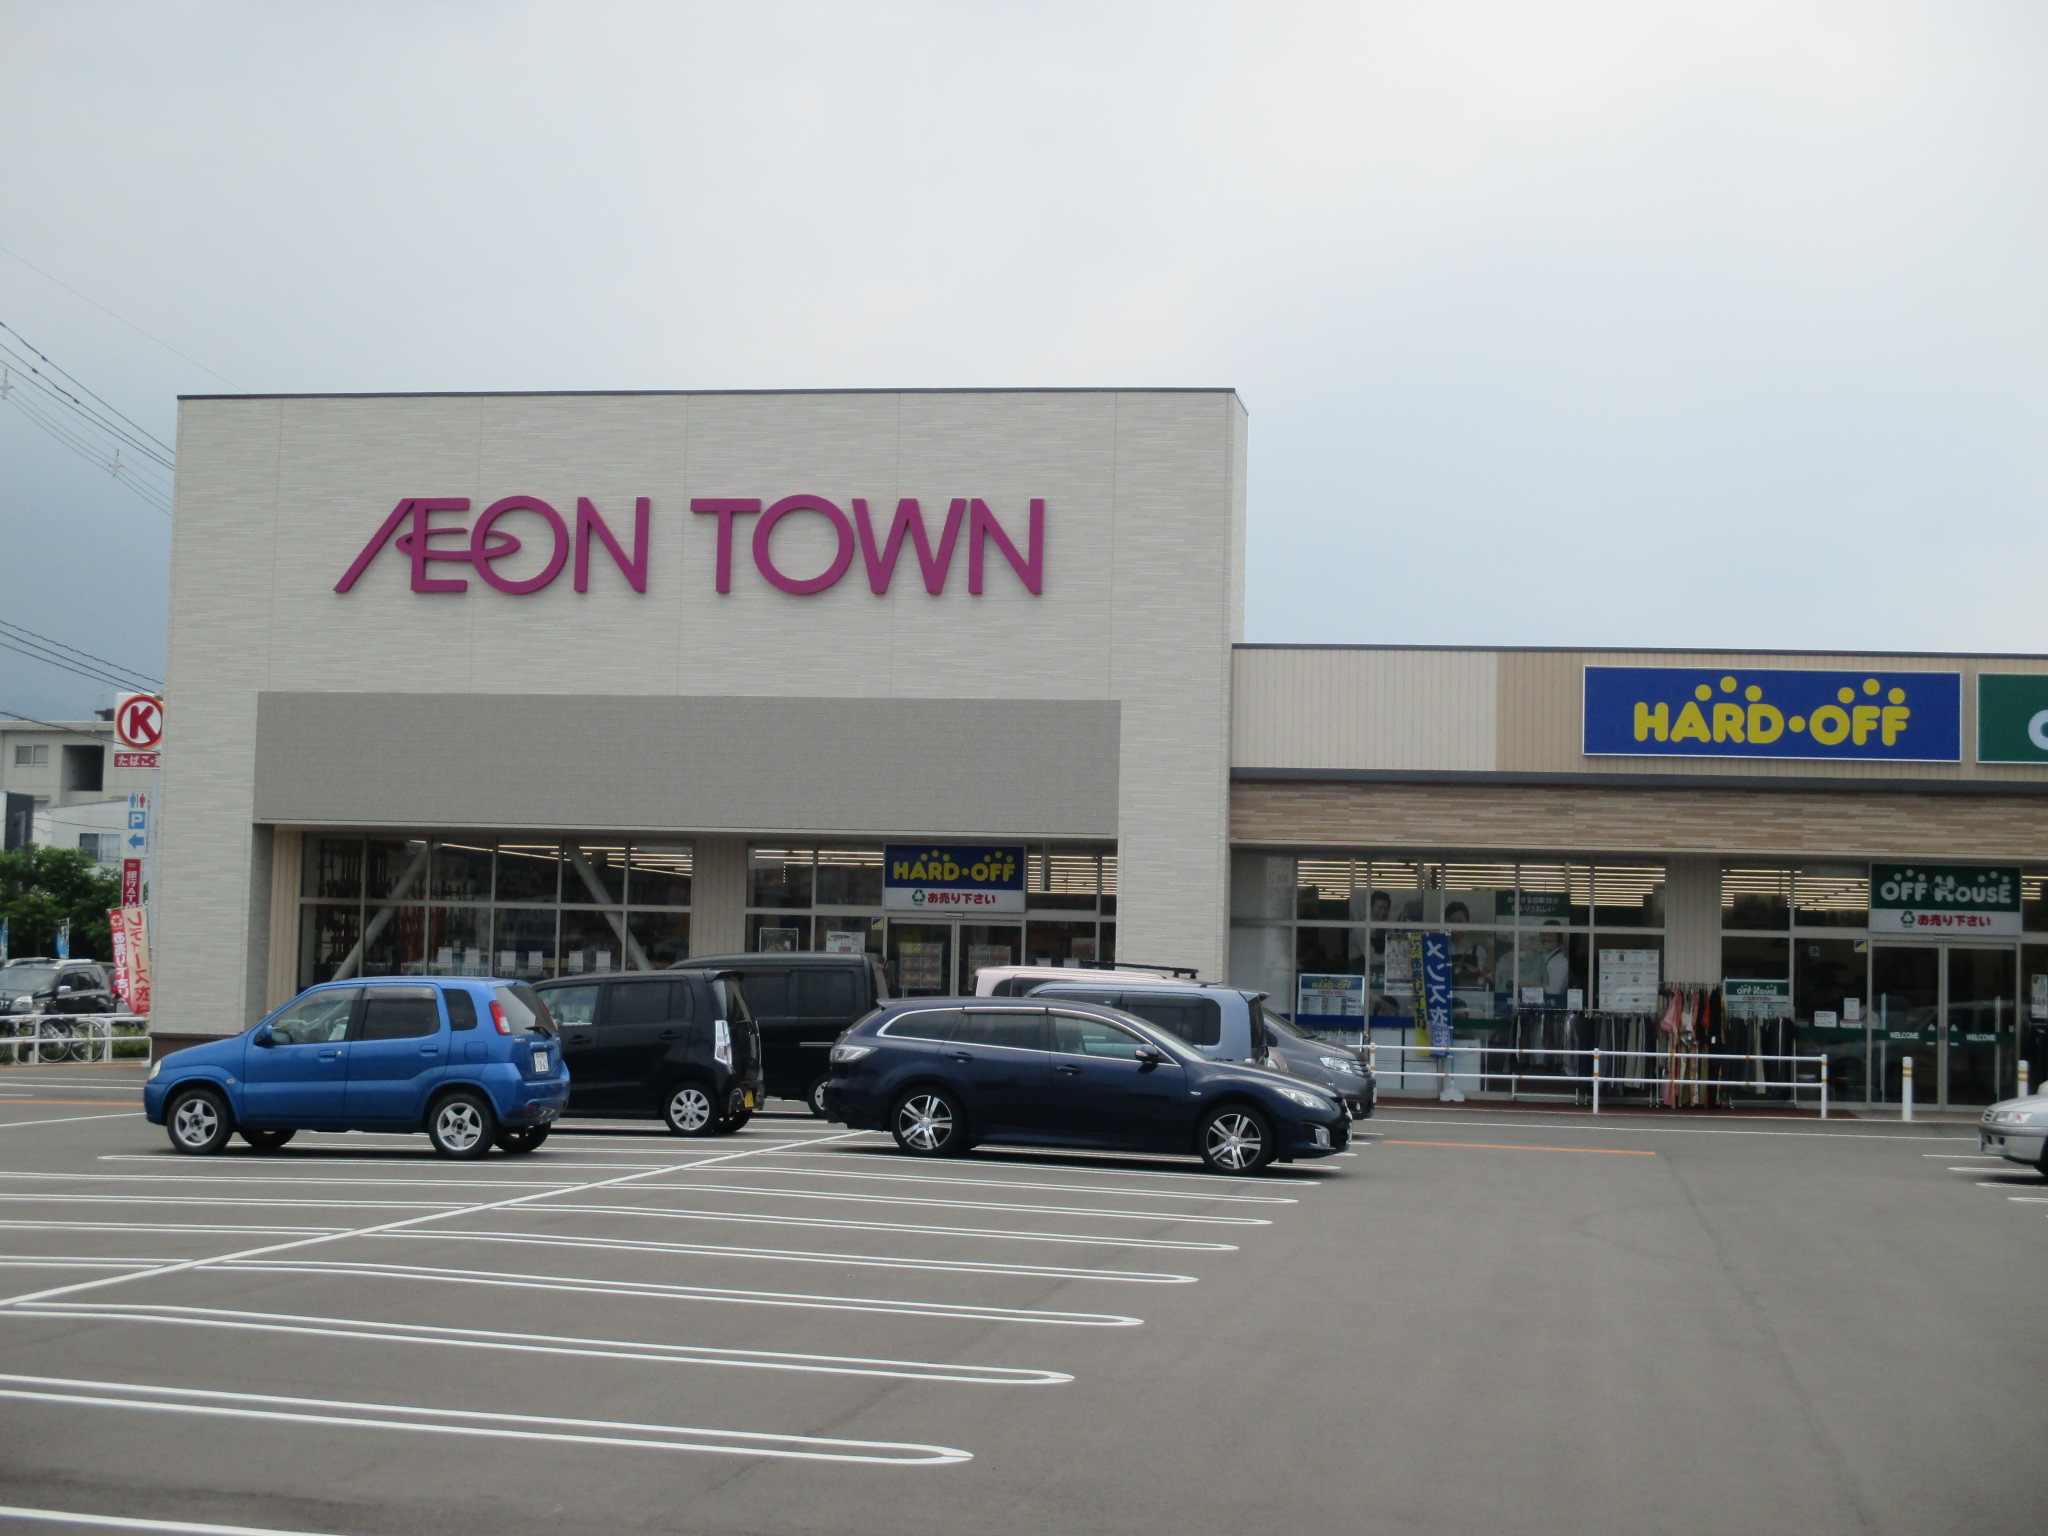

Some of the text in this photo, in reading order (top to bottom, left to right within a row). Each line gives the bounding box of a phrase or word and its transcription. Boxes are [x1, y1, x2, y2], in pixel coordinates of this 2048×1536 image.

[691, 494, 1044, 595] TOWN
[131, 813, 144, 827] P
[1880, 881, 1928, 901] OFF
[927, 892, 996, 905] お売り下さい
[1917, 914, 1991, 927] お売り下さい
[1889, 1031, 1920, 1040] WELCOME
[1965, 1033, 1996, 1042] WELCOME
